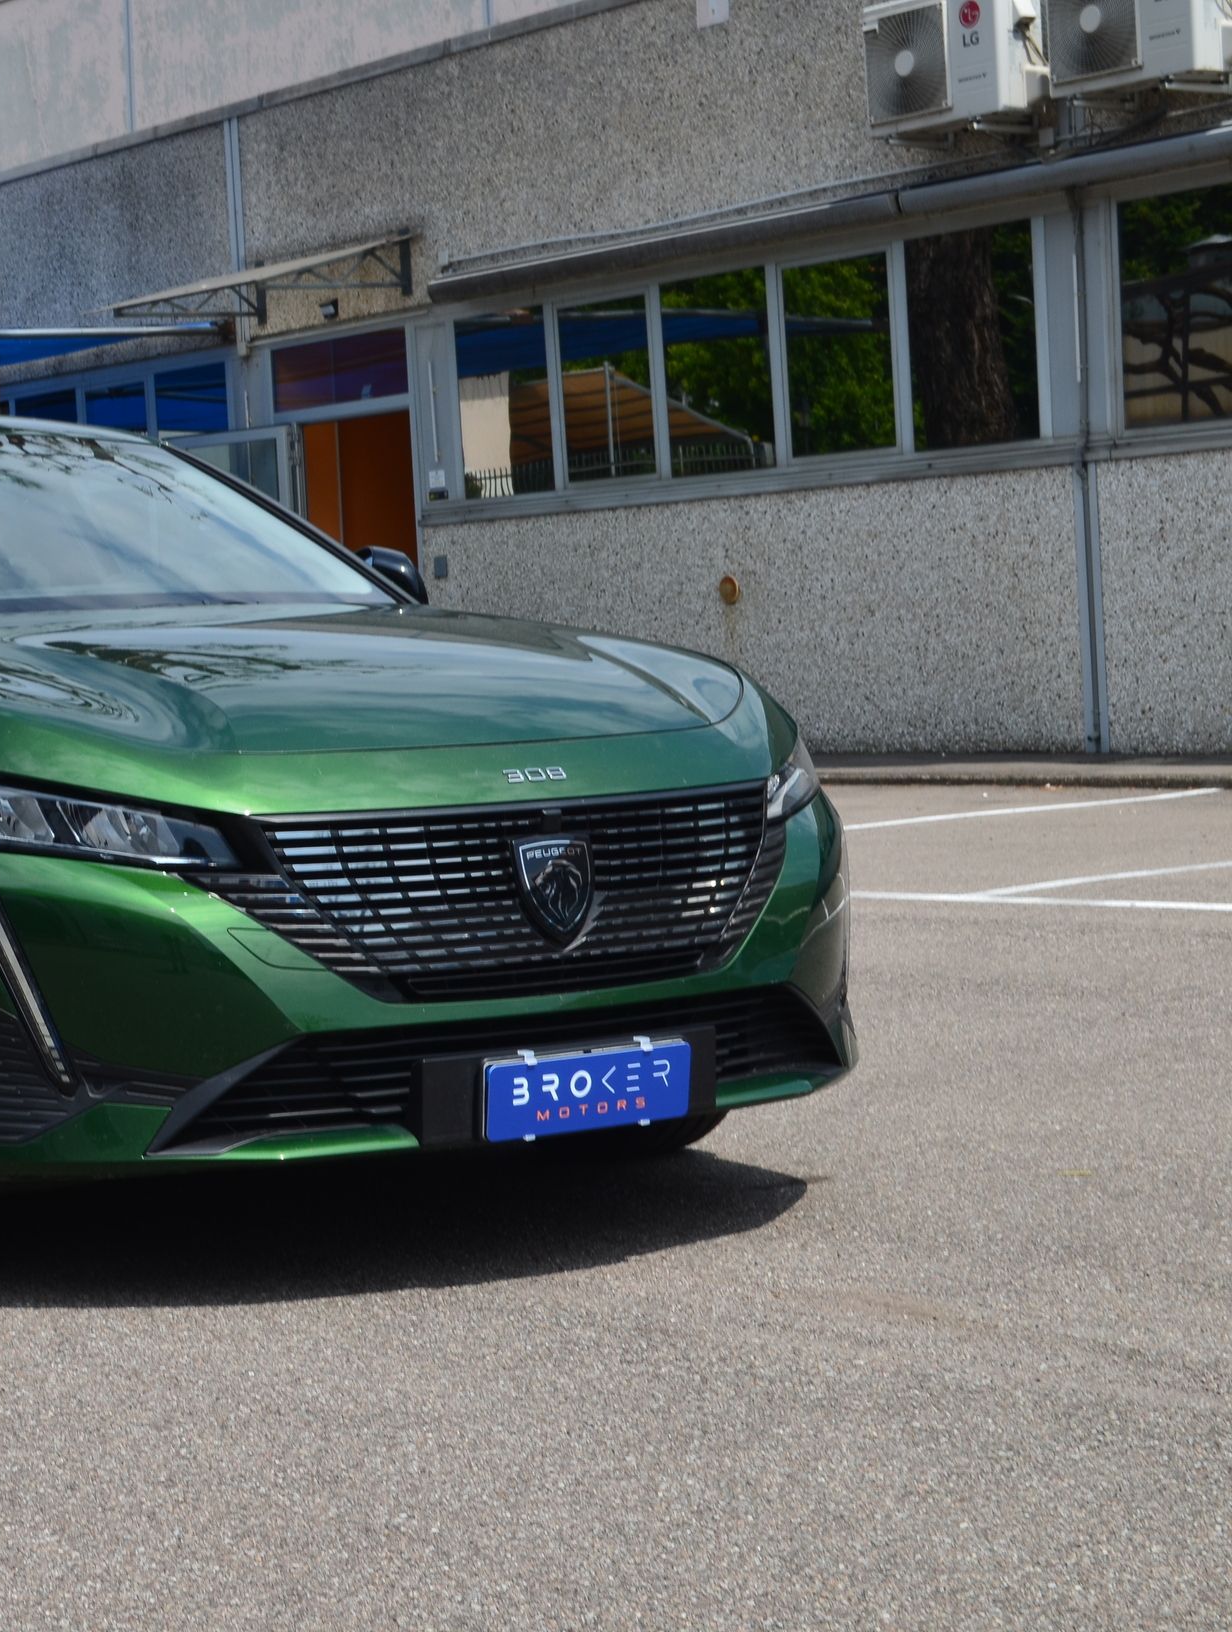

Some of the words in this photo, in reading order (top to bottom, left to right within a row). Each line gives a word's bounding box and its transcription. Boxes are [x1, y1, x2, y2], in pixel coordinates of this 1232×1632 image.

[962, 31, 980, 48] LG
[502, 766, 567, 783] 308
[526, 847, 582, 861] PEUGEOT
[512, 1059, 671, 1106] BROKER
[536, 1096, 647, 1121] MOTORS
